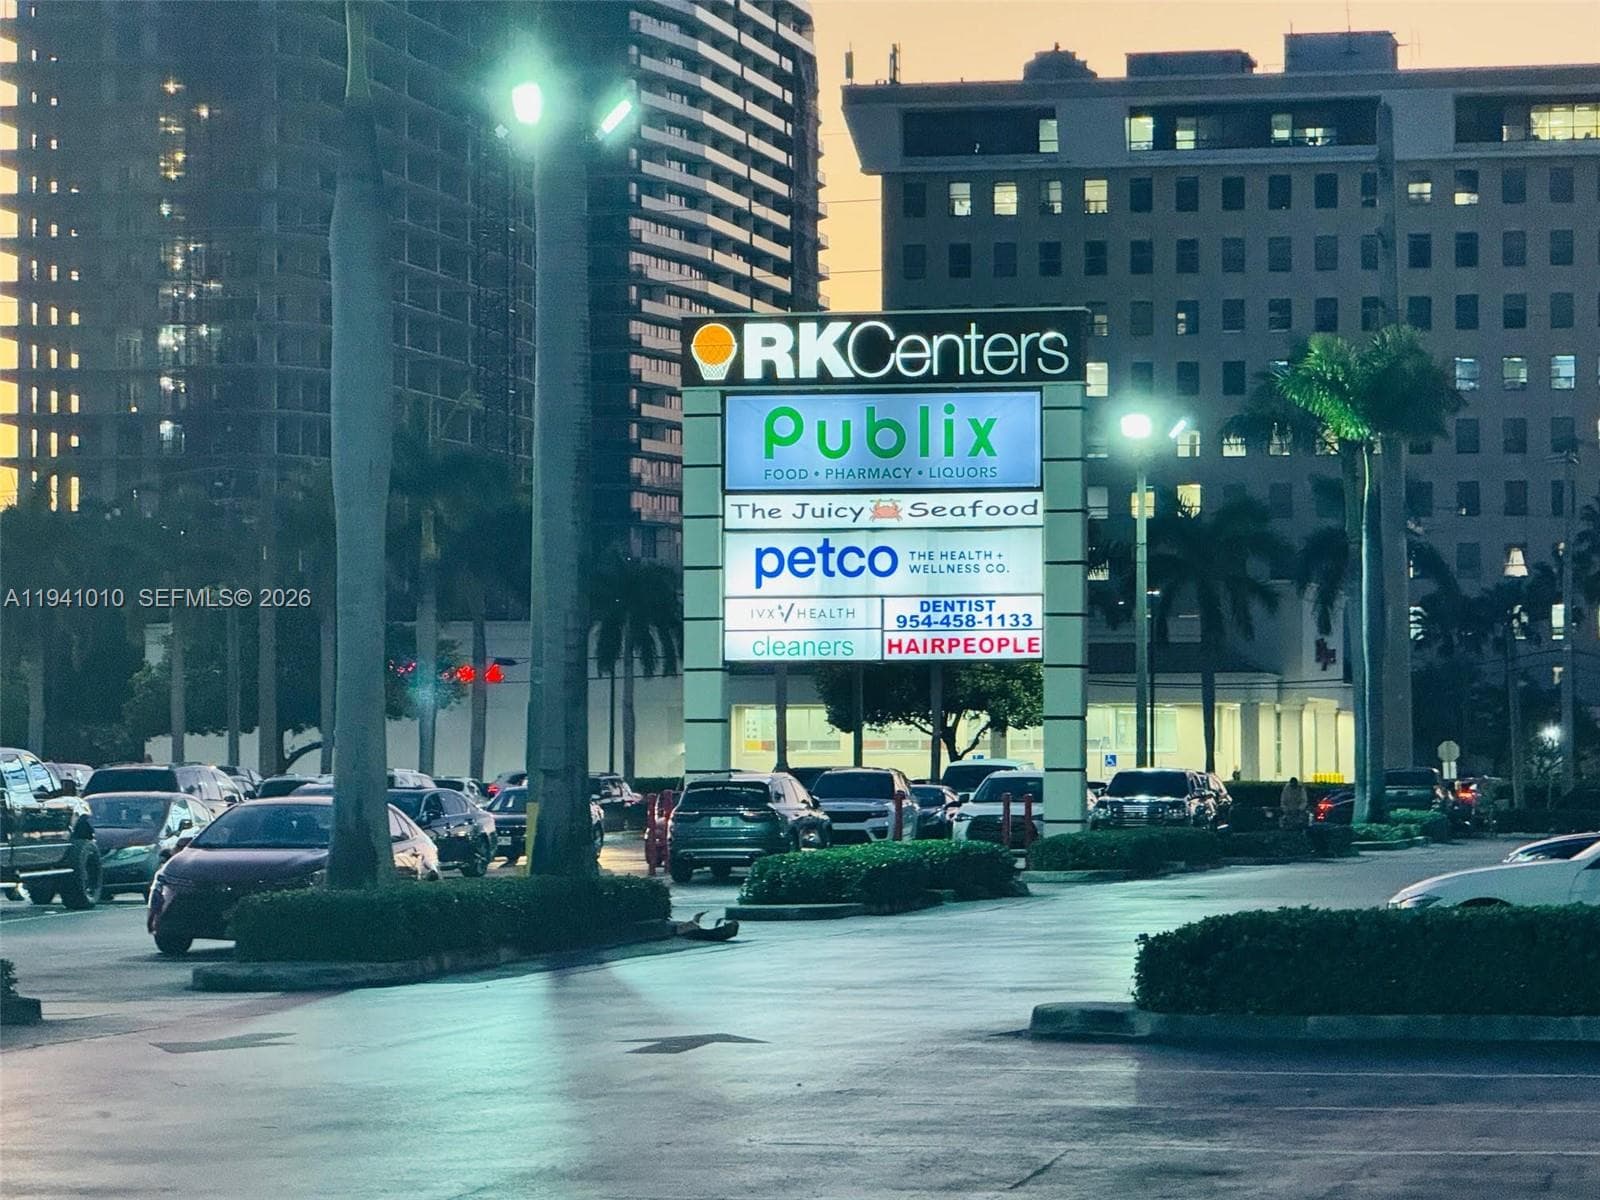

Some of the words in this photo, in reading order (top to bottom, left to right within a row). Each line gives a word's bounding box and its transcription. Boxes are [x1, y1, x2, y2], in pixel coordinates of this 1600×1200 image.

[764, 402, 997, 459] Publix
[764, 467, 808, 480] FOOD
[825, 467, 912, 480] PHARMACY
[929, 466, 997, 479] LIQUORS
[731, 503, 782, 519] The
[792, 502, 864, 522] Juicy
[908, 499, 1038, 518] Seafood
[755, 538, 898, 589] petco
[909, 551, 935, 560] THE
[940, 551, 992, 561] HEALTH
[909, 563, 980, 574] WELLNESS
[985, 563, 1010, 573] CO.
[751, 608, 774, 619] IVX
[797, 607, 855, 619] HEALTH
[920, 599, 996, 613] DENTIST
[896, 613, 1033, 628] 954-458-1133
[753, 635, 854, 656] cleaners
[887, 637, 1040, 655] HAIRPEOPLE
